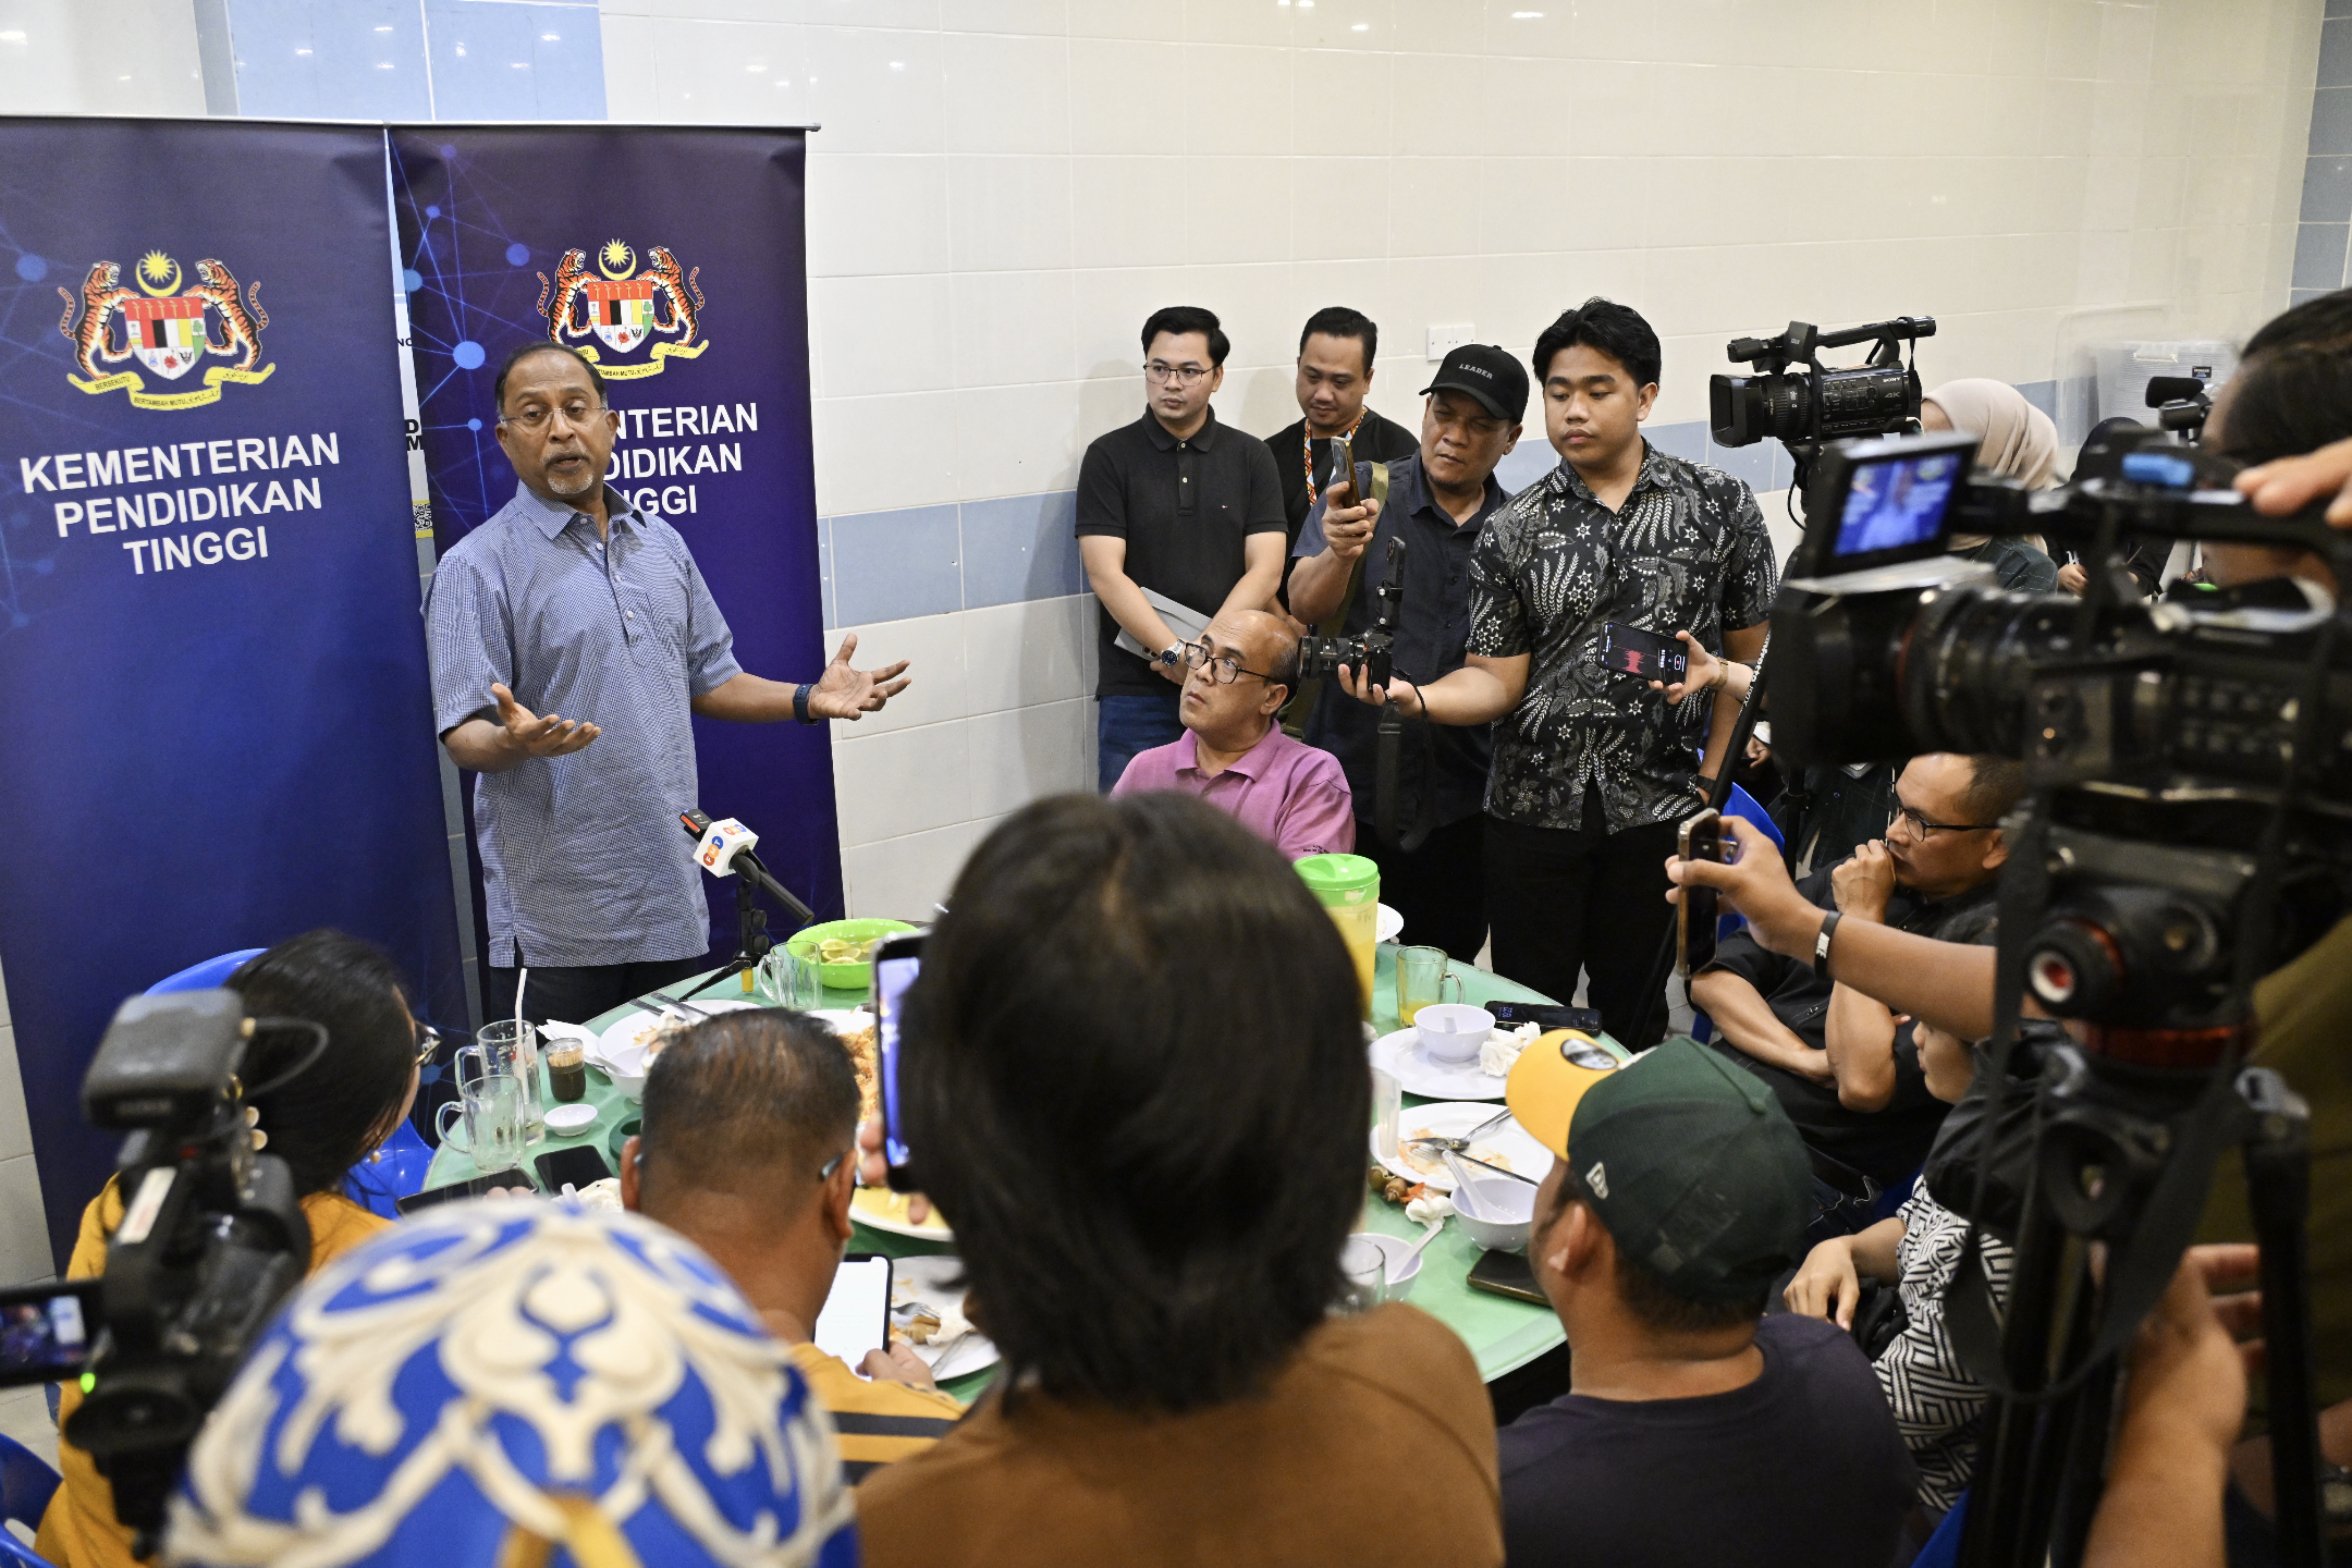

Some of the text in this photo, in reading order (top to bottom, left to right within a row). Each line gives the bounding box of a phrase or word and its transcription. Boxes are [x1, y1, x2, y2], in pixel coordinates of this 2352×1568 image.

[95, 376, 130, 390] BERSEKUTU
[1459, 363, 1493, 379] LEADER
[134, 397, 168, 406] BERTAMBAH
[21, 433, 339, 493] KEMENTERIAN
[603, 443, 741, 480] DIDIKAN
[55, 478, 321, 537] PENDIDIKAN
[123, 526, 268, 574] TINGGI
[704, 837, 722, 865] FMT
[1816, 932, 1830, 959] NIKE
